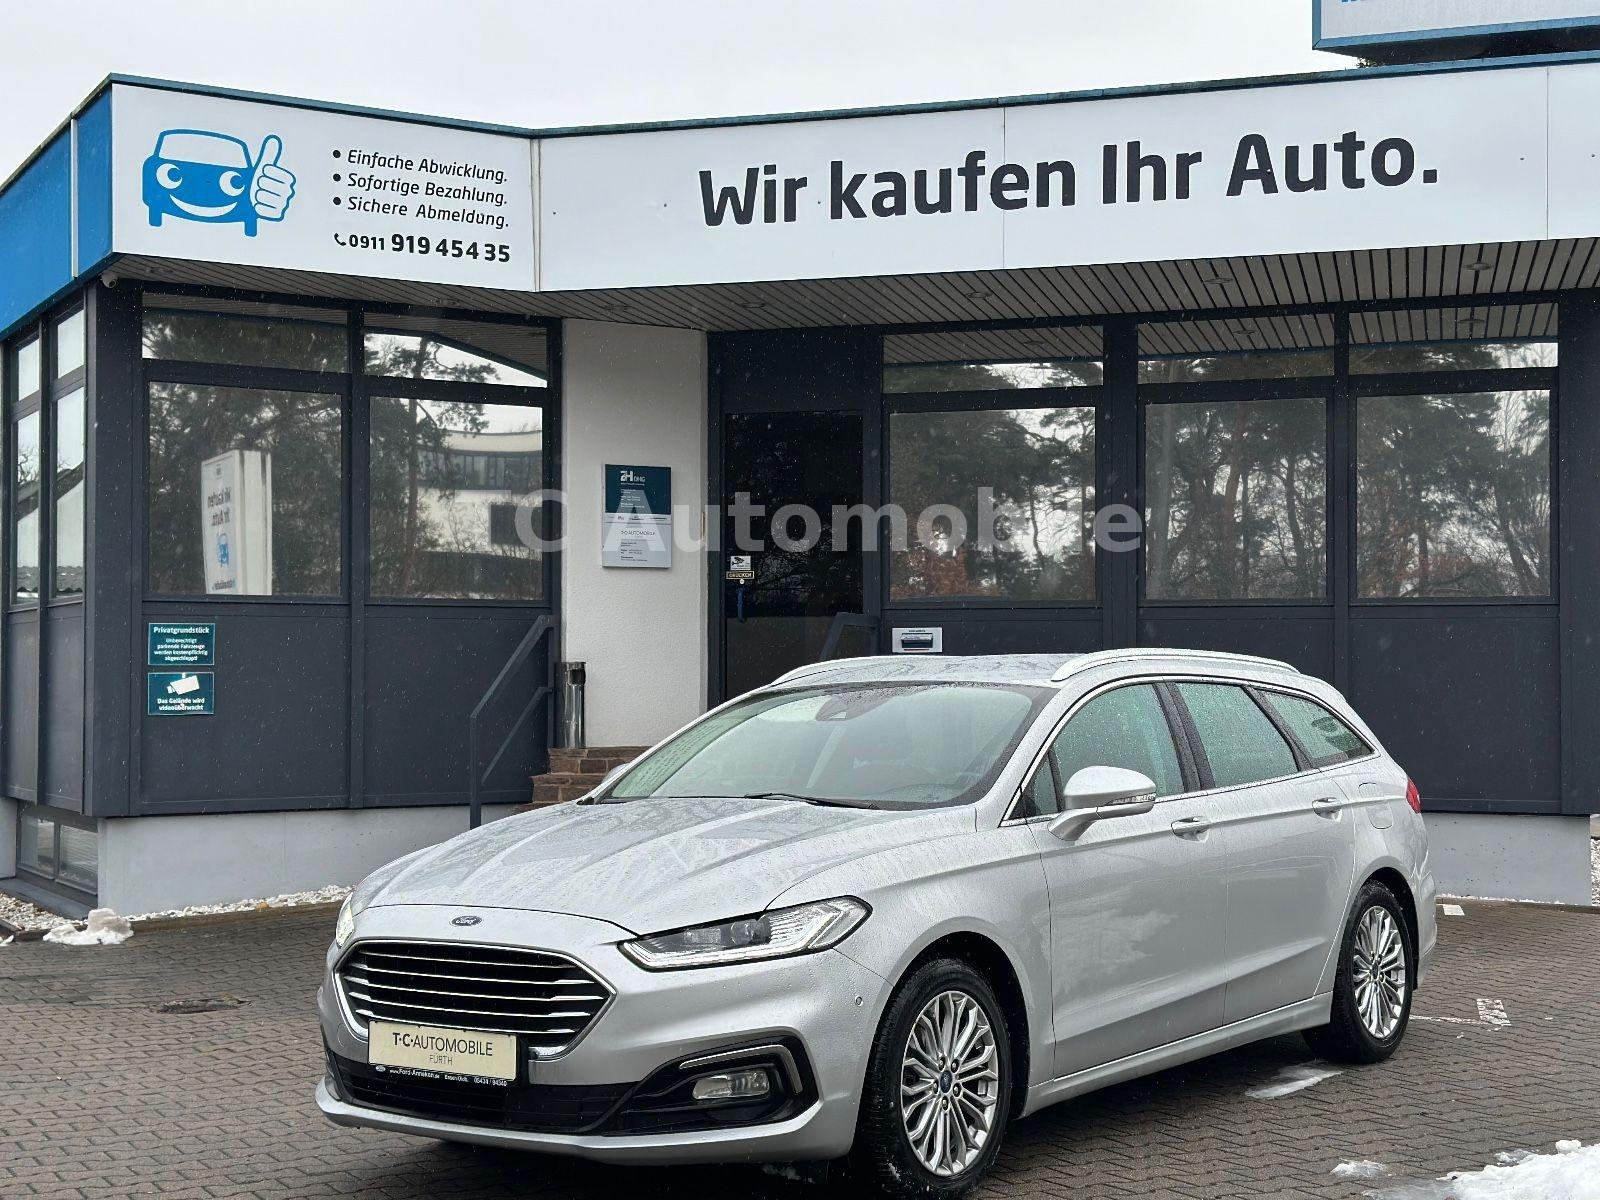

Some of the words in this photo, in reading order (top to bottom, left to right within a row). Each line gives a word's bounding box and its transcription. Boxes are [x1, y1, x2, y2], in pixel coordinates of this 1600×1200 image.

[347, 150, 414, 171] Einfache
[417, 158, 508, 185] Abwicklung.
[698, 163, 808, 227] Wir
[829, 150, 1076, 220] kaufen
[1102, 140, 1203, 205] Ihr
[1225, 130, 1438, 197] Auto.
[347, 172, 420, 196] Sofortige
[424, 181, 508, 207] Bezahlung.
[347, 196, 408, 216] Sichere
[415, 204, 509, 230] Abmeldung.
[348, 234, 385, 251] 0911
[391, 233, 431, 255] 919
[484, 243, 510, 263] 35
[153, 626, 210, 634] Privatgrundstück
[158, 703, 204, 711] videoüberwacht
[429, 1053, 453, 1066] FÜRTH
